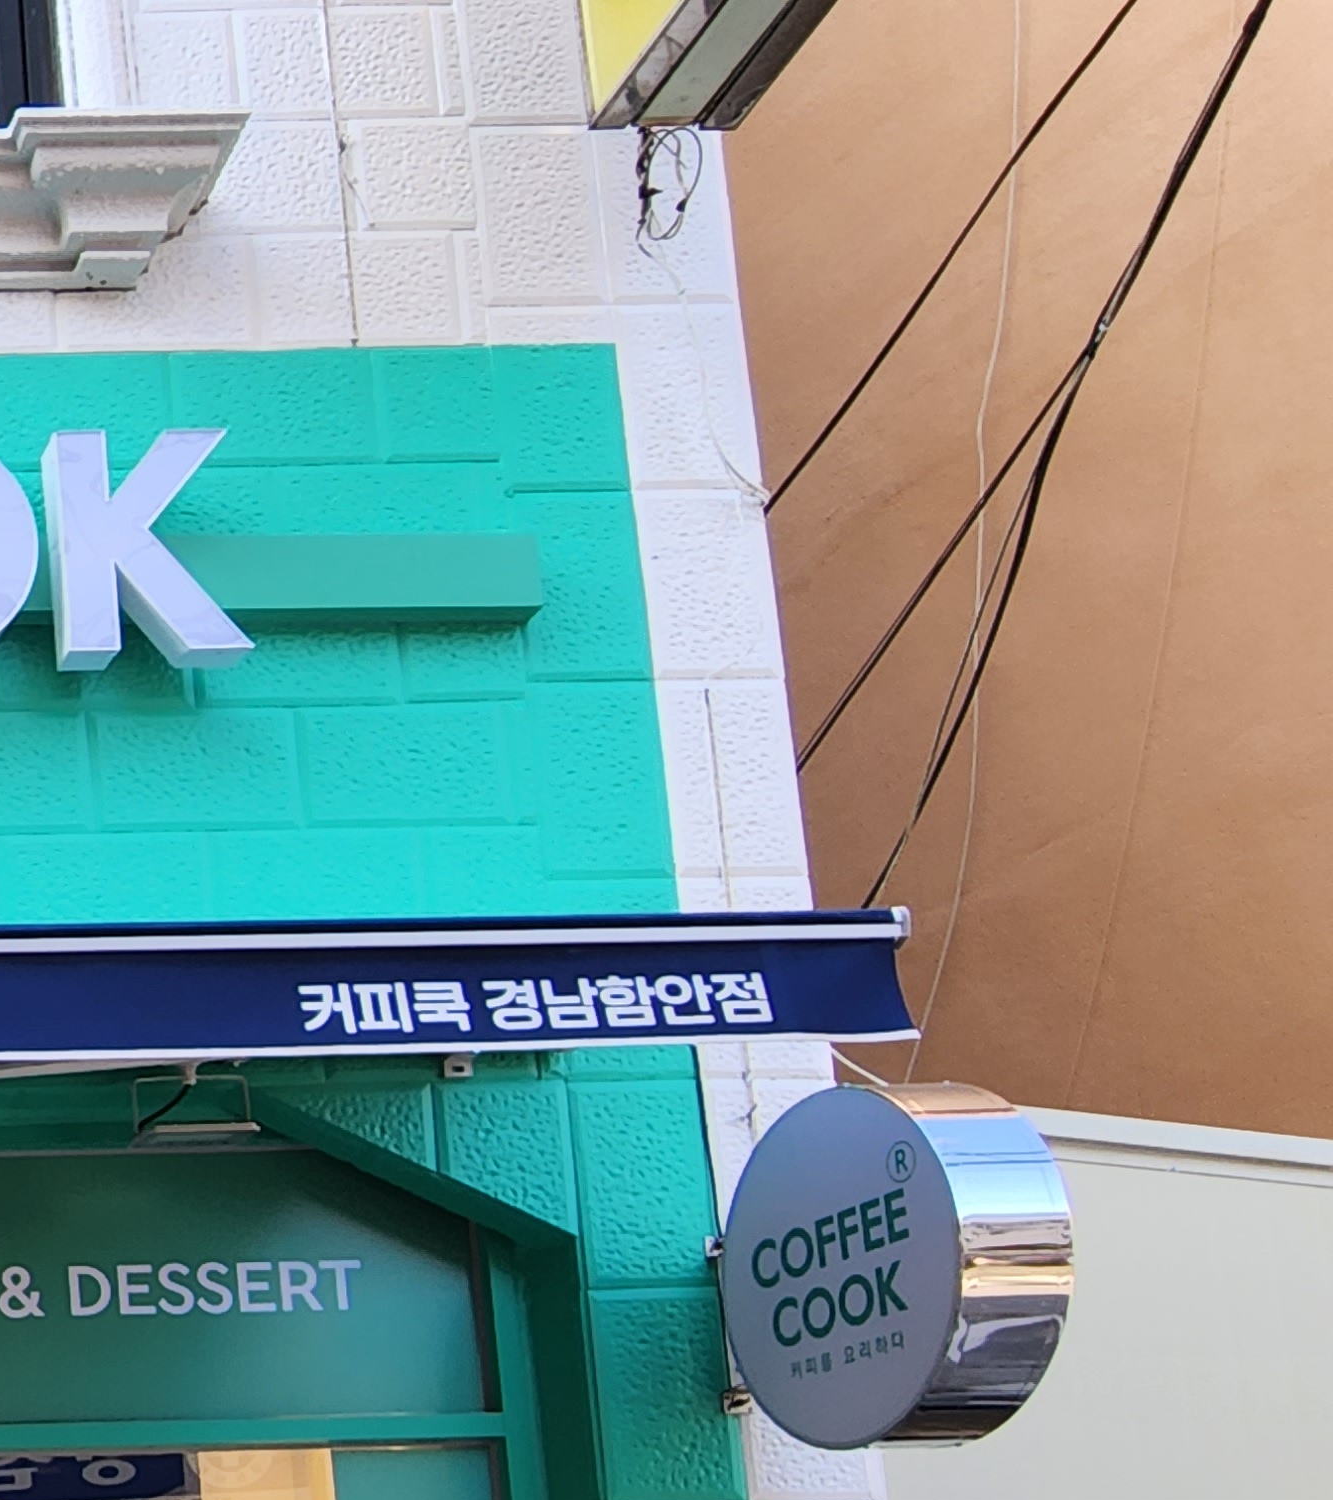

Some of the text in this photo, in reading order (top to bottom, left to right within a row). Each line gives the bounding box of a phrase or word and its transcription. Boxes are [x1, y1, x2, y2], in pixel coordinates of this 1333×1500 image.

[296, 971, 776, 1034] 커피쿡 경남함안점
[751, 1188, 910, 1289] COFFEE
[68, 1259, 362, 1317] DESSERT
[772, 1260, 909, 1347] COOK
[843, 1331, 906, 1364] 요리하다
